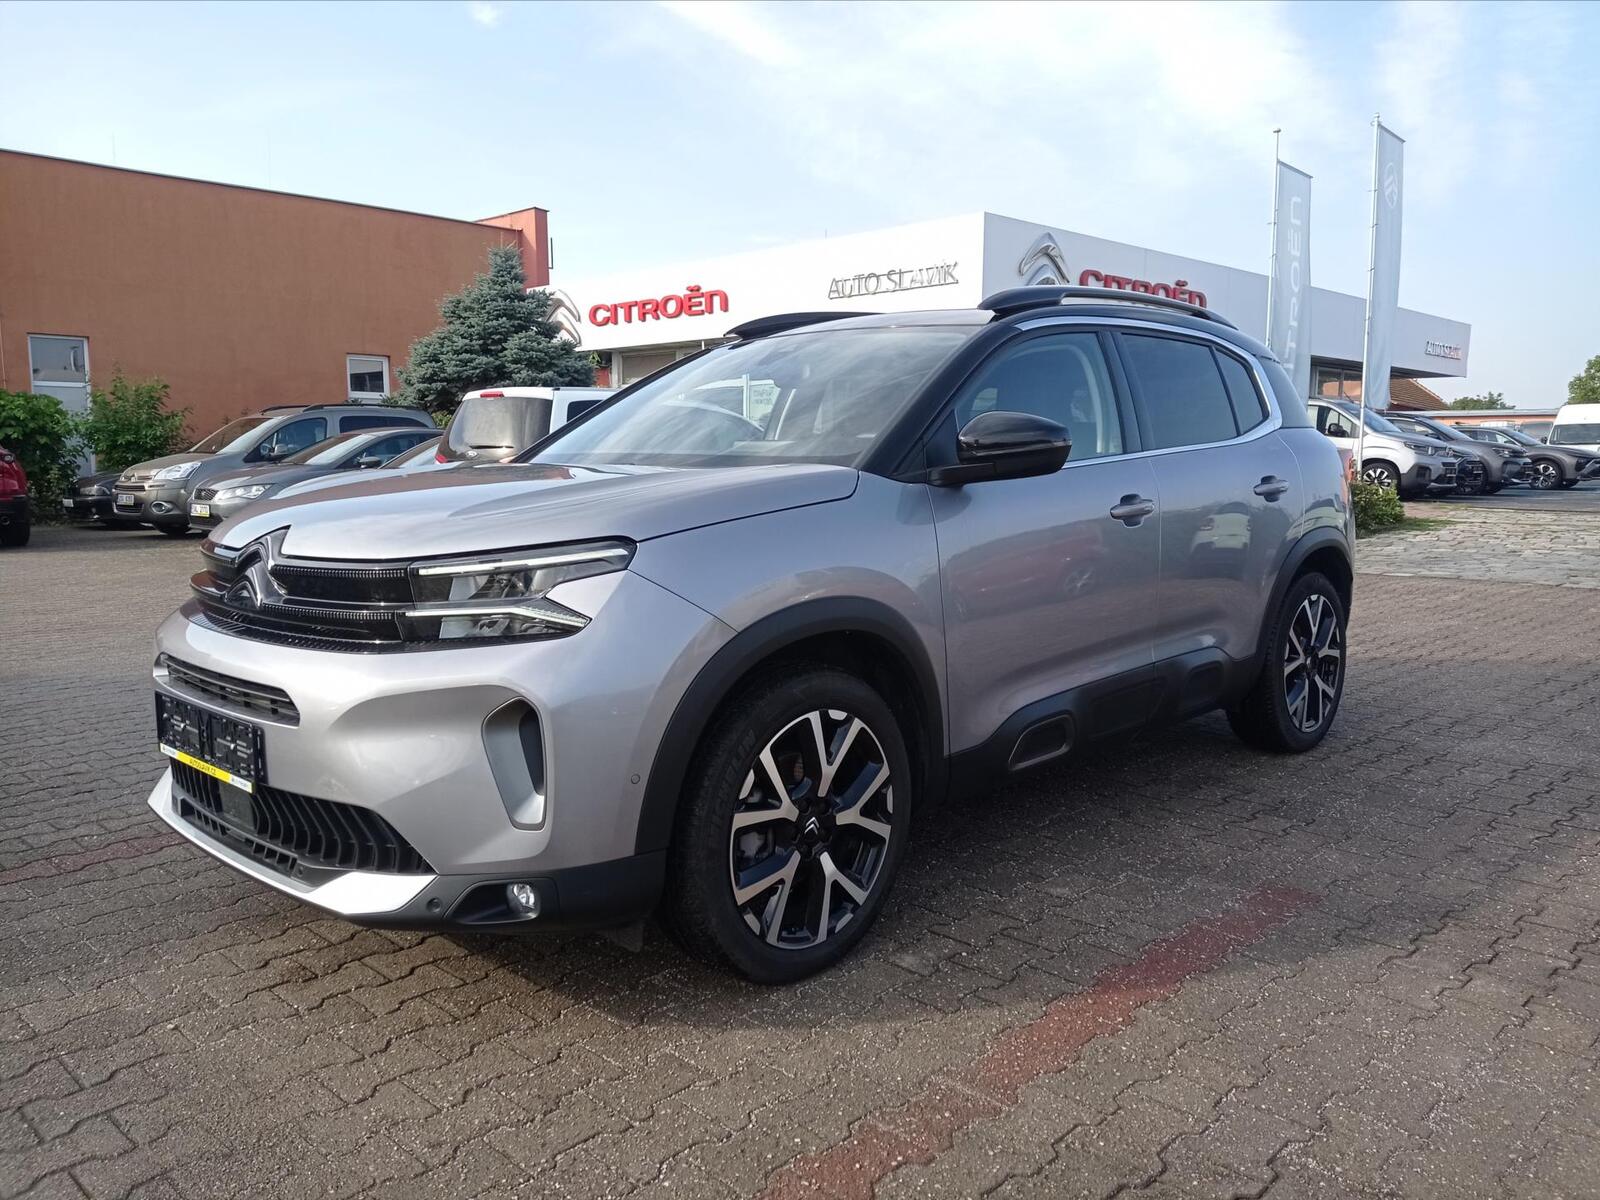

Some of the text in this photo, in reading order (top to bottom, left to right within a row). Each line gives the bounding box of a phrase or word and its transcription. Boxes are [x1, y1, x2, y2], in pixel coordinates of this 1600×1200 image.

[828, 273, 880, 299] AUTO
[1283, 196, 1302, 370] ITROËN
[588, 285, 729, 327] CITROËN
